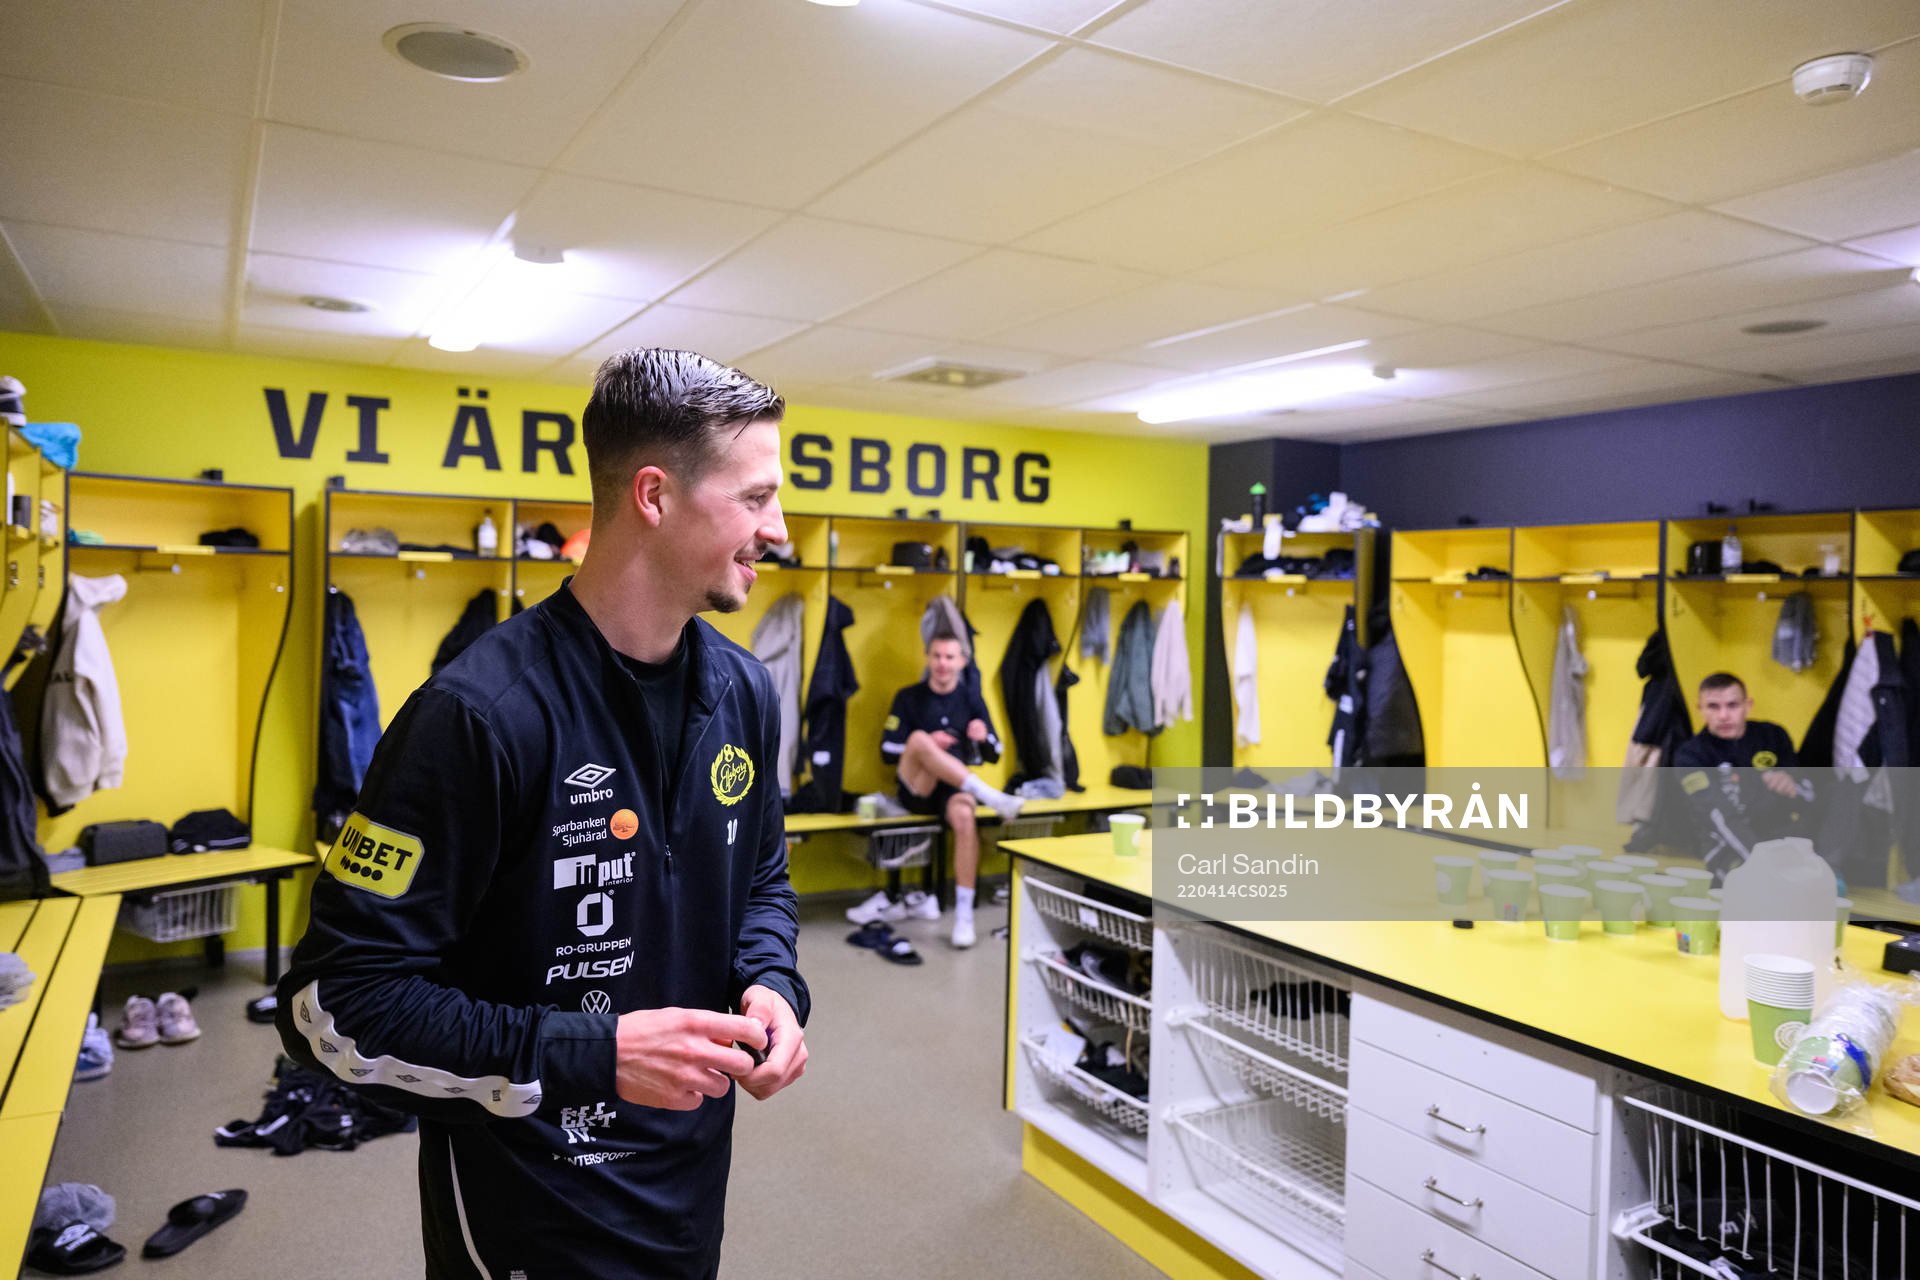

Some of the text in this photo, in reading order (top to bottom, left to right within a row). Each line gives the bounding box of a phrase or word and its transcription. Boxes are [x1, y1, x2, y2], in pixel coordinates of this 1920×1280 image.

[263, 386, 1051, 505] VI ÄR SBORG
[570, 789, 614, 805] umbro
[552, 817, 606, 837] Sparbanken
[562, 828, 607, 847] Sjuhärad
[605, 877, 634, 887] interior
[556, 936, 632, 957] RO-GRUPPEN
[545, 951, 635, 985] PULSEN
[563, 1151, 637, 1168] NTERSPORT
